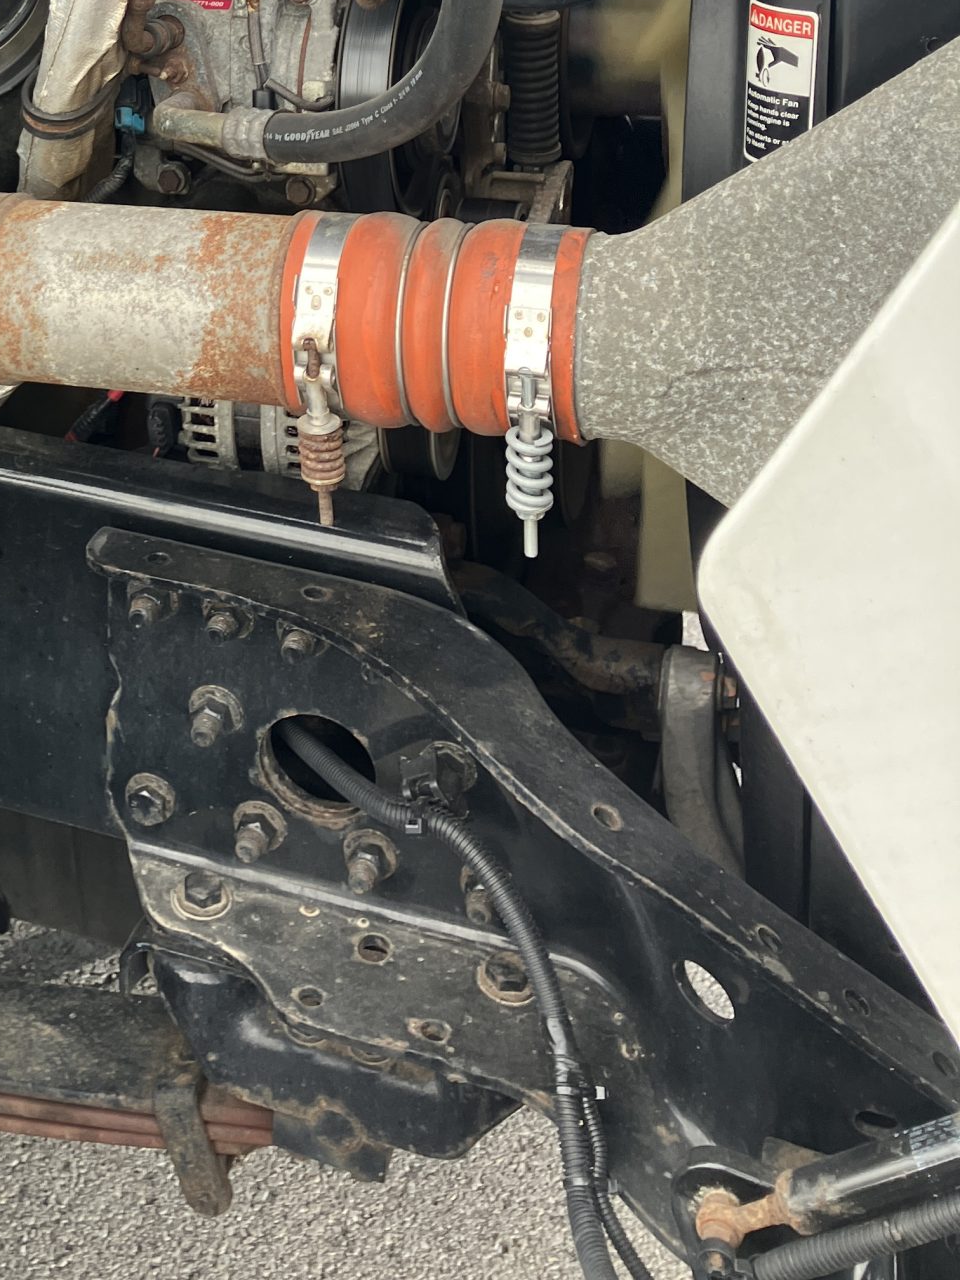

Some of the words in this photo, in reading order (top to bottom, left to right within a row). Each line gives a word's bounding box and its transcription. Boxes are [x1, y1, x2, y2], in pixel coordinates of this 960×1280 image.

[759, 14, 812, 36] DANGER
[748, 87, 781, 106] Automatic
[781, 98, 799, 108] Fan
[747, 99, 758, 111] Keep
[759, 105, 779, 118] hands
[780, 110, 800, 120] clear
[759, 113, 781, 127] engine
[782, 119, 790, 127] is
[284, 128, 330, 143] GOODYEAR
[332, 128, 344, 137] SAE
[361, 115, 374, 126] Type
[755, 130, 772, 144] starts
[772, 137, 781, 145] or
